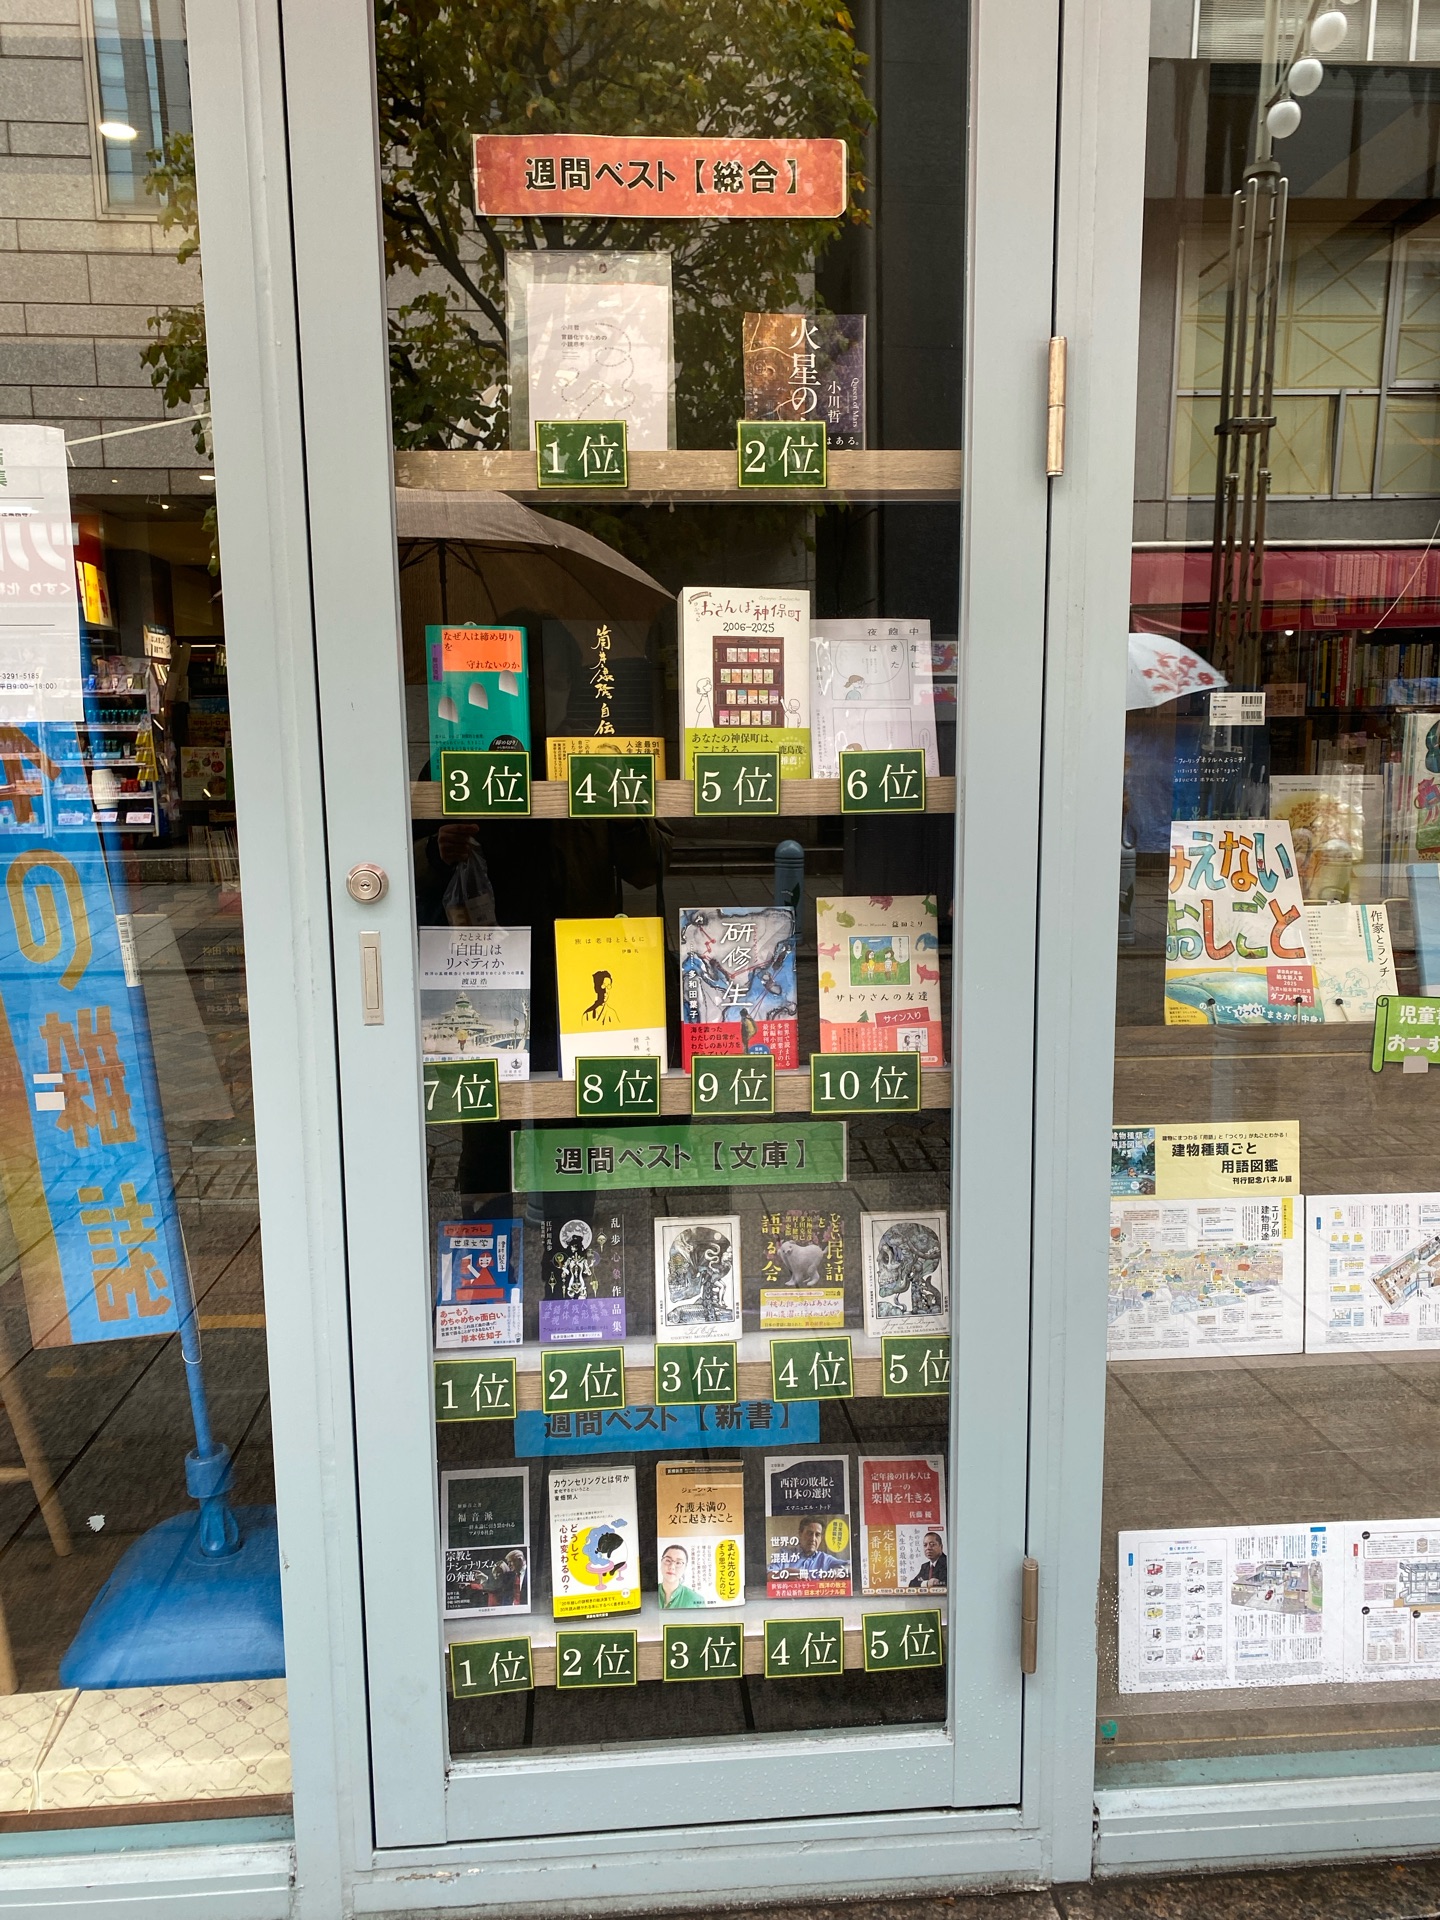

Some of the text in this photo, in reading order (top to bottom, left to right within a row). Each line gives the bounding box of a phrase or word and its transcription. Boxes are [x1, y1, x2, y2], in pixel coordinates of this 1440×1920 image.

[788, 318, 822, 421] 火星の
[828, 381, 841, 424] 小川哲
[546, 436, 621, 479] 1位
[744, 436, 821, 479] 2位
[444, 632, 514, 641] なぜ人は締め切り
[723, 622, 775, 633] 2006-2025
[867, 627, 878, 652] 夜は
[445, 643, 453, 651] を
[467, 660, 520, 669] 守れないのか
[692, 733, 774, 744] あなたの神保町は、
[449, 765, 524, 805] 3位
[575, 768, 649, 807] 4位
[701, 766, 773, 805] 5位
[847, 763, 919, 803] 6位
[459, 932, 494, 941] たとえば
[1166, 892, 1306, 961] おしごと
[451, 942, 502, 956] 「自由」は
[1371, 910, 1390, 977] 作家とランチ
[446, 957, 505, 970] リバティか
[720, 922, 757, 1006] 研修生
[688, 969, 698, 1019] 多和田葉子
[835, 991, 928, 1002] サトウさんの友達
[1199, 1002, 1233, 1013] のいて
[1236, 1005, 1263, 1015] びっくり
[883, 1011, 922, 1024] サイン入り
[1399, 1004, 1440, 1026] 児童
[424, 1074, 494, 1112] 7位
[582, 1069, 654, 1107] 8位
[698, 1068, 769, 1106] 9位
[819, 1065, 909, 1104] 10位
[1171, 1142, 1258, 1158] 建物種類ごと
[1221, 1158, 1279, 1174] 用語図鑑
[1232, 1175, 1293, 1185] 刊行記念パネル展
[1260, 1205, 1270, 1241] 建物用途
[1271, 1205, 1280, 1238] エリア別
[610, 1217, 622, 1332] 乱歩心象作品集
[440, 1307, 469, 1319] あーもう
[440, 1312, 507, 1326] めちゃめちゃ面白い。
[548, 1361, 619, 1402] 2位
[661, 1355, 731, 1395] 3位
[778, 1350, 847, 1391] 4位
[889, 1348, 950, 1387] 5位
[441, 1372, 511, 1412] 1位
[554, 1475, 630, 1488] カウンセリングとは何か
[780, 1476, 835, 1489] 西洋の敗北と
[871, 1472, 931, 1481] 定年後の日本人は
[872, 1482, 911, 1493] 世界一の
[675, 1501, 727, 1513] 介護未満の
[784, 1488, 832, 1500] 日本の選択
[871, 1493, 932, 1504] 楽園を生きる
[668, 1512, 733, 1525] 父に起きたこと
[446, 1550, 472, 1561] 宗教と
[570, 1524, 579, 1562] どうして
[770, 1536, 799, 1547] 世界の
[770, 1552, 800, 1563] 混乱が
[869, 1529, 882, 1585] 一番楽しい
[882, 1529, 896, 1580] 定年後が
[446, 1560, 497, 1572] ナショナリズム
[559, 1524, 571, 1593] 心は変わるの?
[727, 1539, 736, 1599] 「まだ先のこと」
[771, 1566, 849, 1580] この一冊でわかる!
[446, 1571, 476, 1583] の奔流
[670, 1636, 737, 1672] 3位
[770, 1631, 838, 1668] 4位
[870, 1623, 937, 1661] 5位
[459, 1650, 527, 1687] 1位
[562, 1643, 631, 1679] 2位
